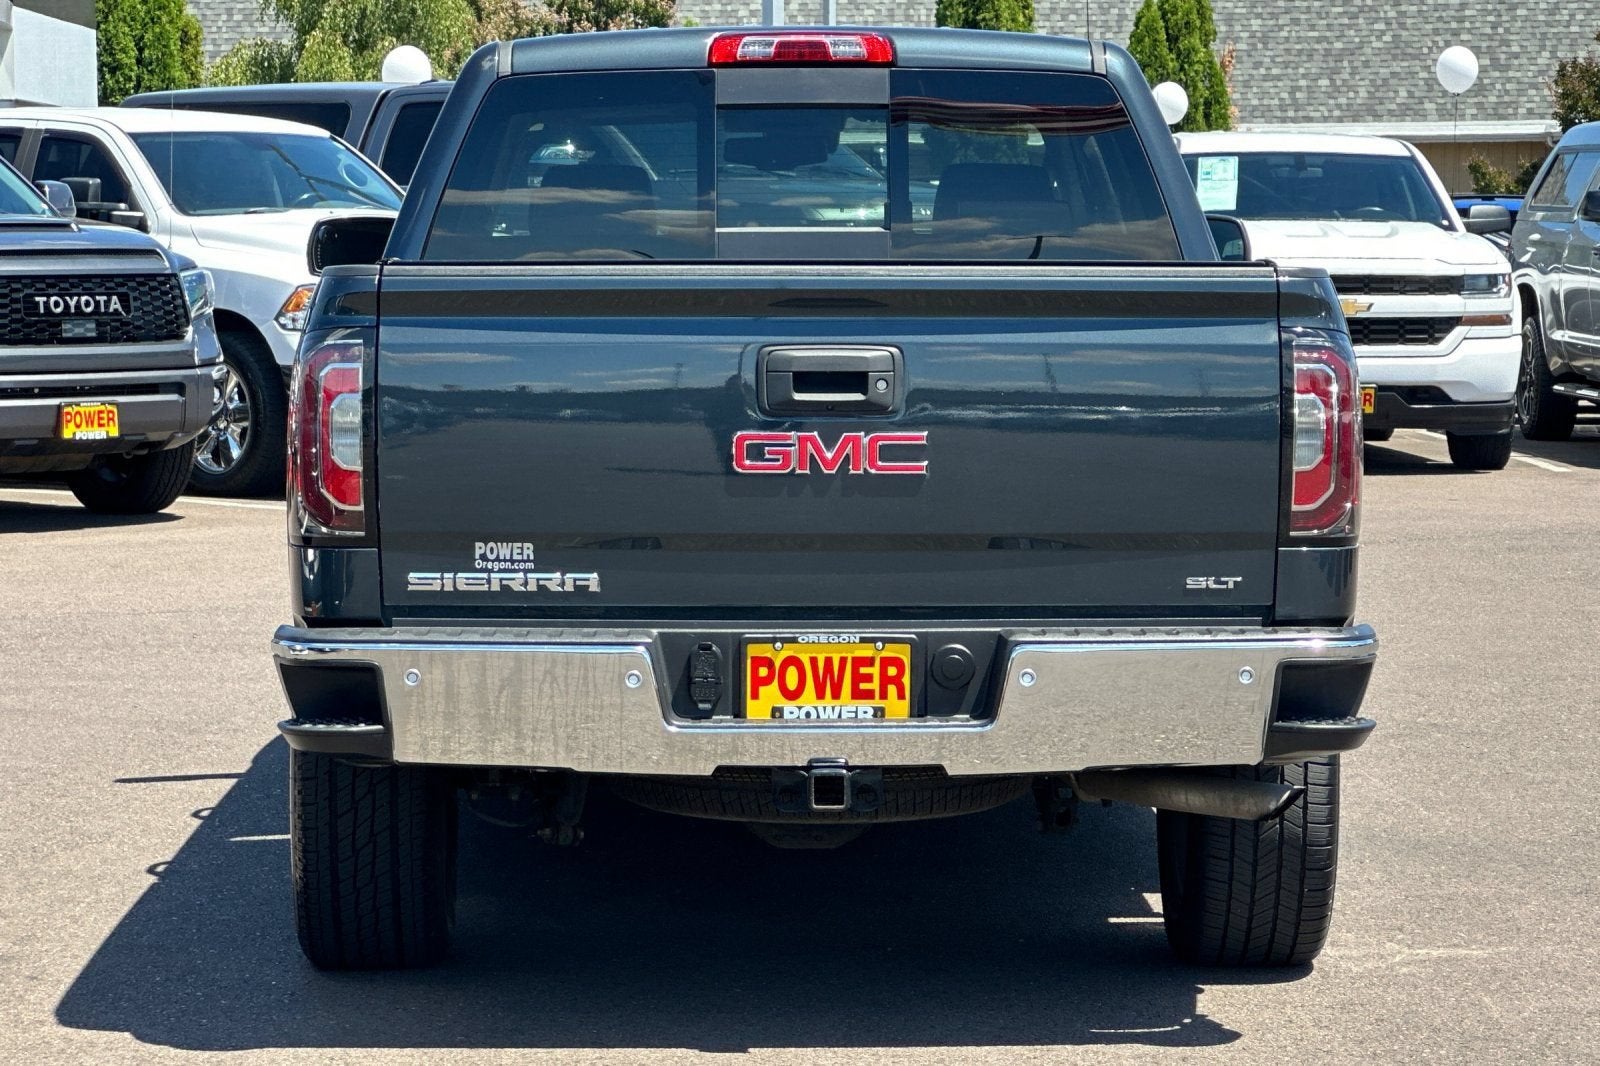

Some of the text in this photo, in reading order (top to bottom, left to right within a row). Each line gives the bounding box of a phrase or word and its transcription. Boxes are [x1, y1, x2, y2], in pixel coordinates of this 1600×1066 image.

[34, 295, 127, 317] TOYOTA
[64, 410, 116, 429] POWER
[76, 430, 107, 440] POWER
[733, 431, 928, 475] GMC
[474, 542, 534, 560] POWER
[475, 560, 535, 571] Oregon.com
[407, 572, 600, 592] SIERRA
[1185, 576, 1243, 589] SLT
[797, 635, 860, 644] OREGON
[750, 655, 906, 701] POWER
[783, 706, 874, 719] POWER
